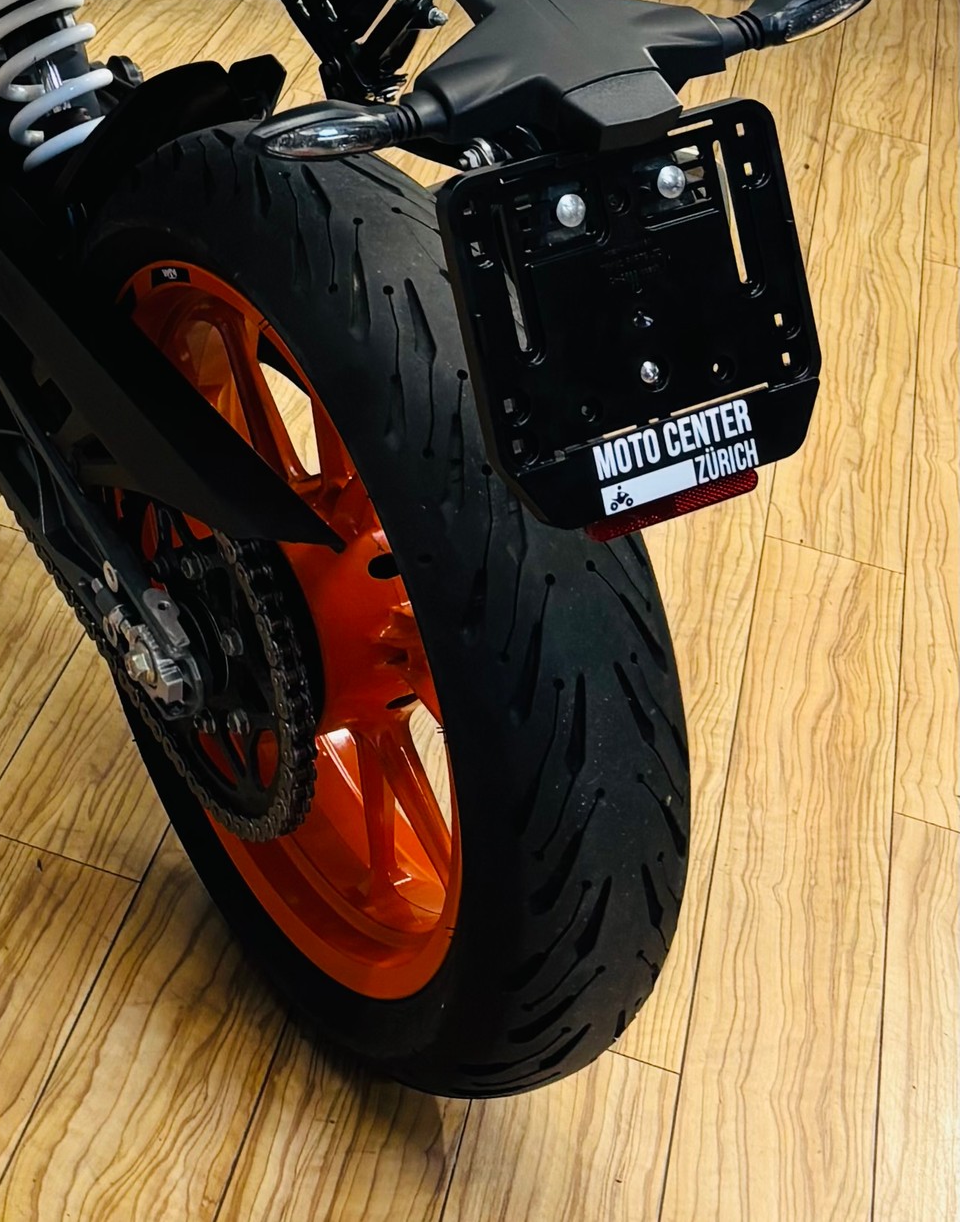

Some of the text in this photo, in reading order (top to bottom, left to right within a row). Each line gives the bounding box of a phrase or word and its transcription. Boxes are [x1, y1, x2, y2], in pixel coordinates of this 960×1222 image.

[592, 399, 753, 481] MOTO CENTER
[695, 438, 760, 485] ZÜRICH
